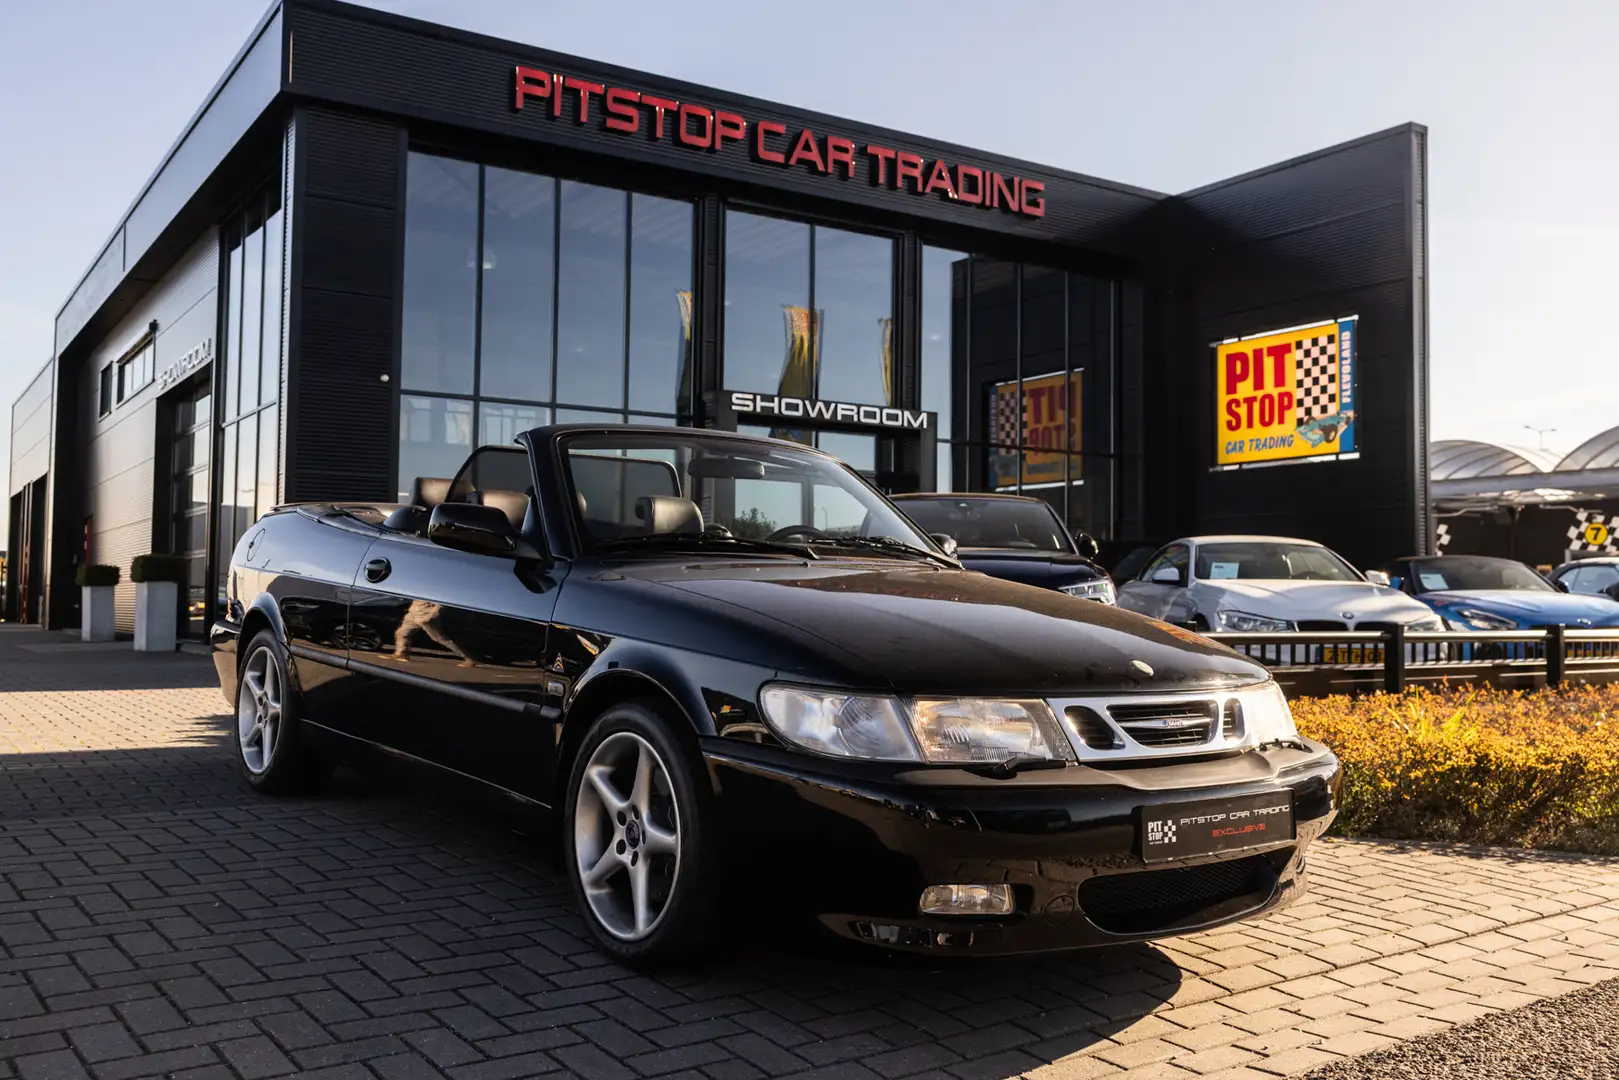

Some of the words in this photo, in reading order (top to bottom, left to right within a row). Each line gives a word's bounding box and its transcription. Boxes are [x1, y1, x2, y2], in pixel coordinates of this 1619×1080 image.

[515, 66, 746, 150] PITSTOP
[757, 121, 855, 177] CAR
[867, 145, 1045, 217] TRADING
[1225, 343, 1292, 395] PIT
[731, 393, 928, 429] SHOWROOM
[1225, 391, 1294, 432] STOP
[1225, 440, 1245, 455] CAR
[1249, 434, 1294, 452] TRADING
[1590, 527, 1602, 541] 7
[1180, 814, 1227, 825] PITSTOP
[1229, 811, 1251, 820] CAR
[1148, 821, 1163, 833] PIT
[1211, 823, 1266, 837] EXCLUSIVE
[1148, 832, 1163, 841] STOP
